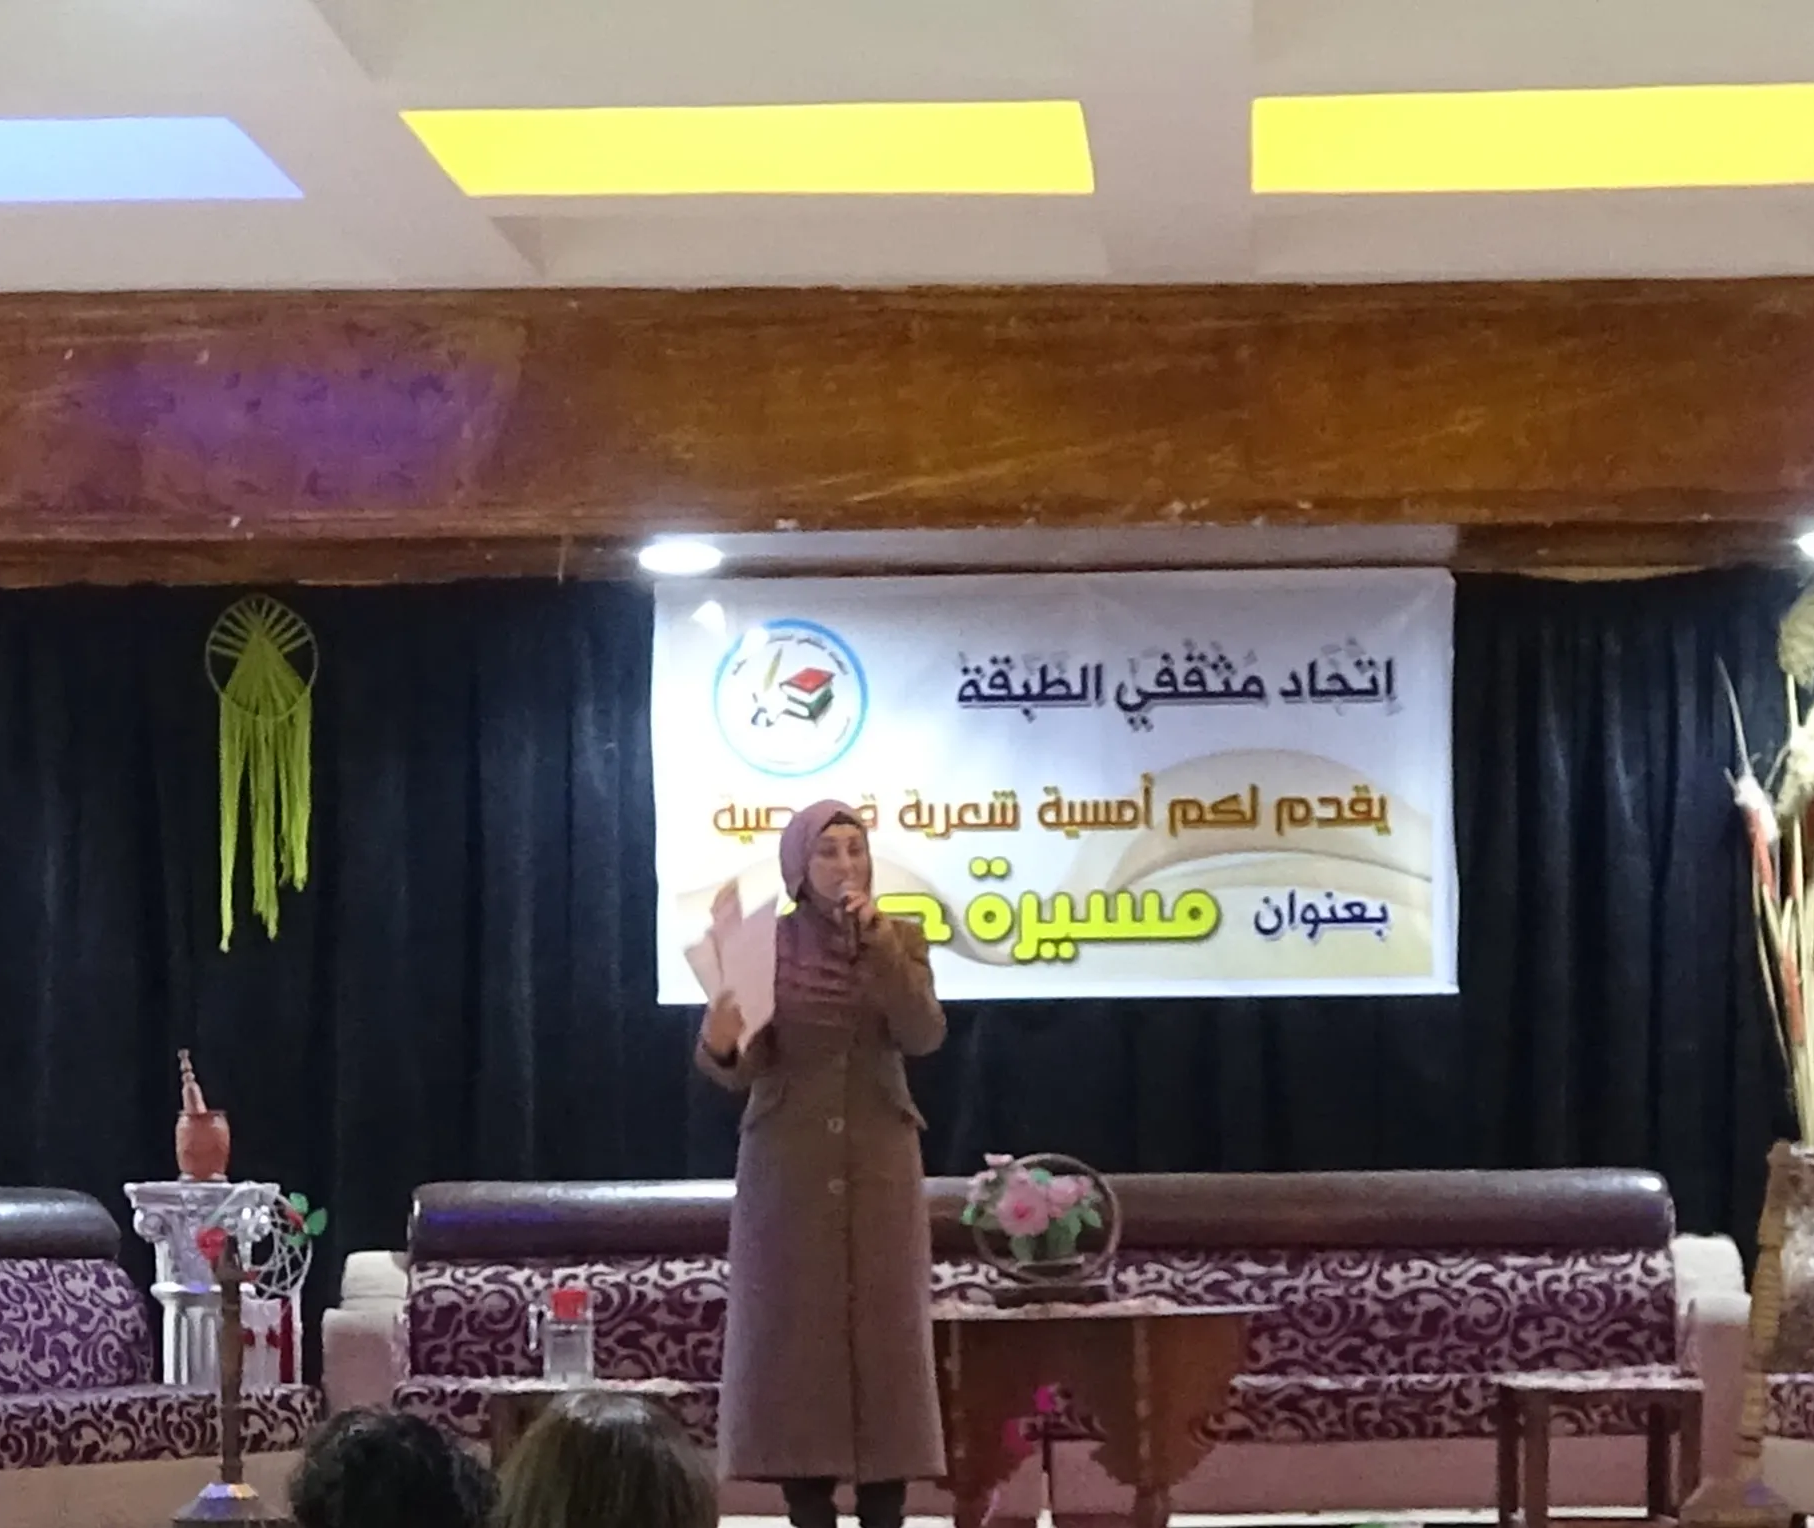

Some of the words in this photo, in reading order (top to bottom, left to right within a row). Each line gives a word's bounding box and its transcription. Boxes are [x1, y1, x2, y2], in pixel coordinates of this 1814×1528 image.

[898, 789, 1021, 840] شعرية
[1037, 772, 1155, 839] أمسية
[1167, 784, 1258, 836] لكم
[1275, 783, 1391, 837] يقدم
[967, 855, 1221, 962] مسيرة
[1253, 889, 1390, 944] بعنوان
